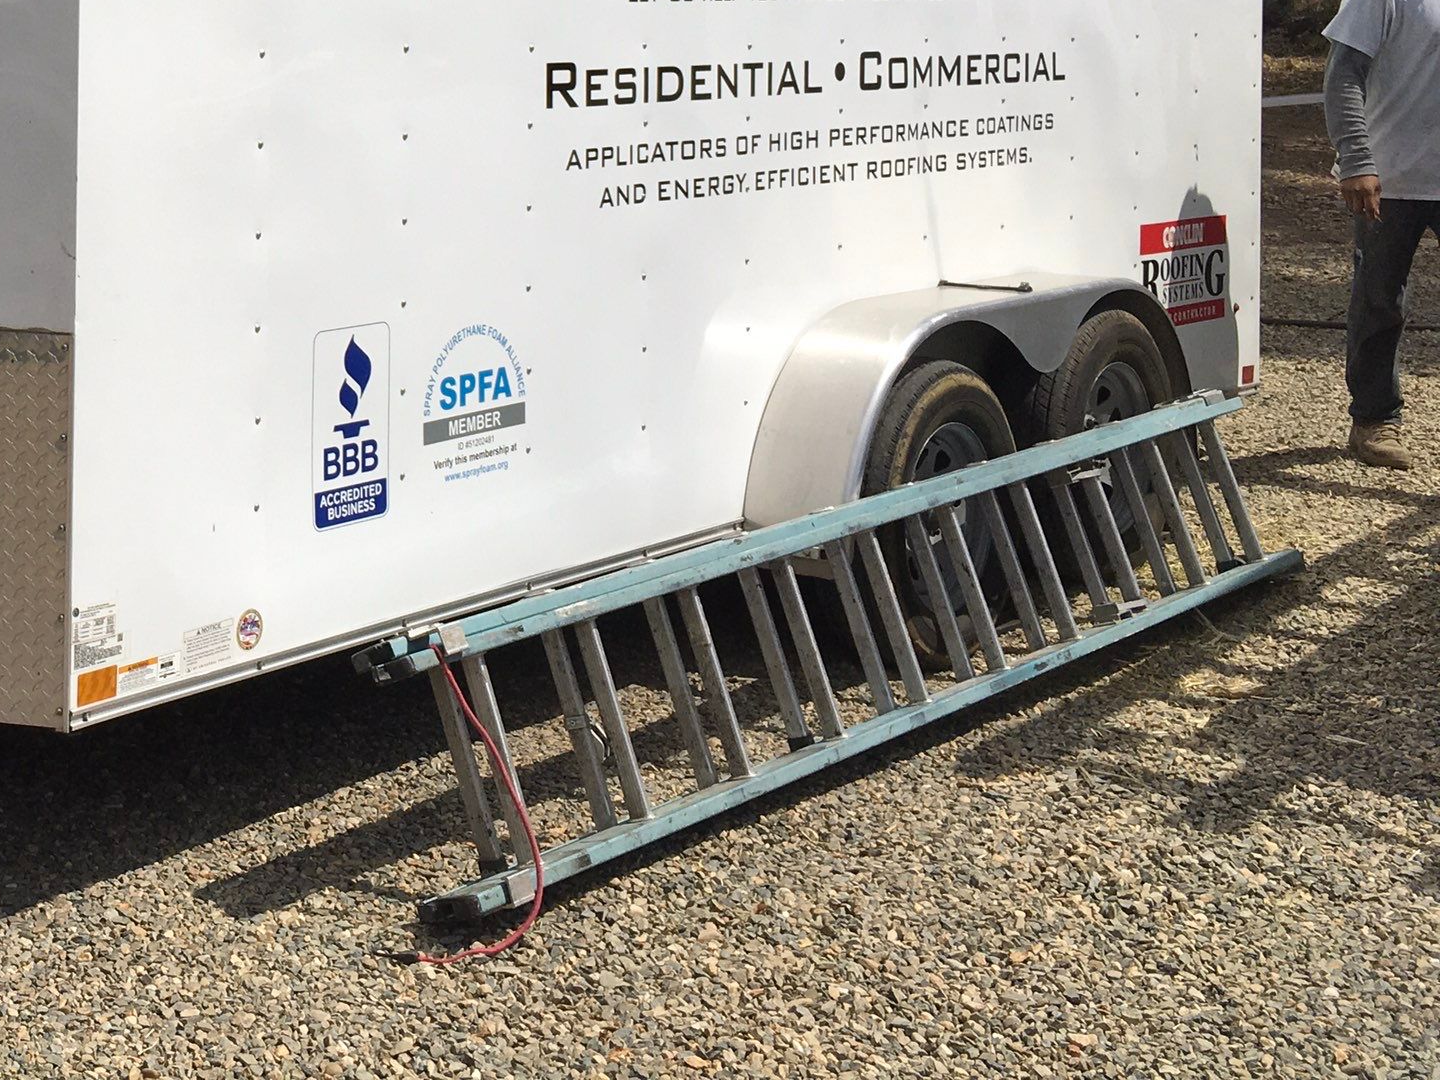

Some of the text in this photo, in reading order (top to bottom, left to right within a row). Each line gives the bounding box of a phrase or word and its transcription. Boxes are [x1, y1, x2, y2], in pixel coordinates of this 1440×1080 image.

[546, 51, 1066, 109] RESIDENTIAL COMMERCIAL
[566, 113, 1054, 171] APPLICATORS OF HIGH PERFORMANCE COATINGS
[599, 183, 646, 208] AND
[755, 163, 858, 191] EFFICIENT
[867, 154, 947, 180] ROOFING
[956, 147, 1033, 170] SYSTEMS.
[1141, 249, 1226, 298] ROOFING
[1163, 281, 1204, 304] SYSTEMS
[423, 324, 526, 417] SPRAY POLYURETHANE FOAM ALLIANCE
[440, 366, 512, 410] SPFA
[448, 411, 502, 436] MEMBER
[323, 438, 379, 481] BBB
[455, 454, 468, 465] this
[469, 443, 509, 461] membership
[511, 443, 518, 452] at
[319, 483, 383, 508] ACCREDITED
[327, 498, 376, 521] BUSINESS
